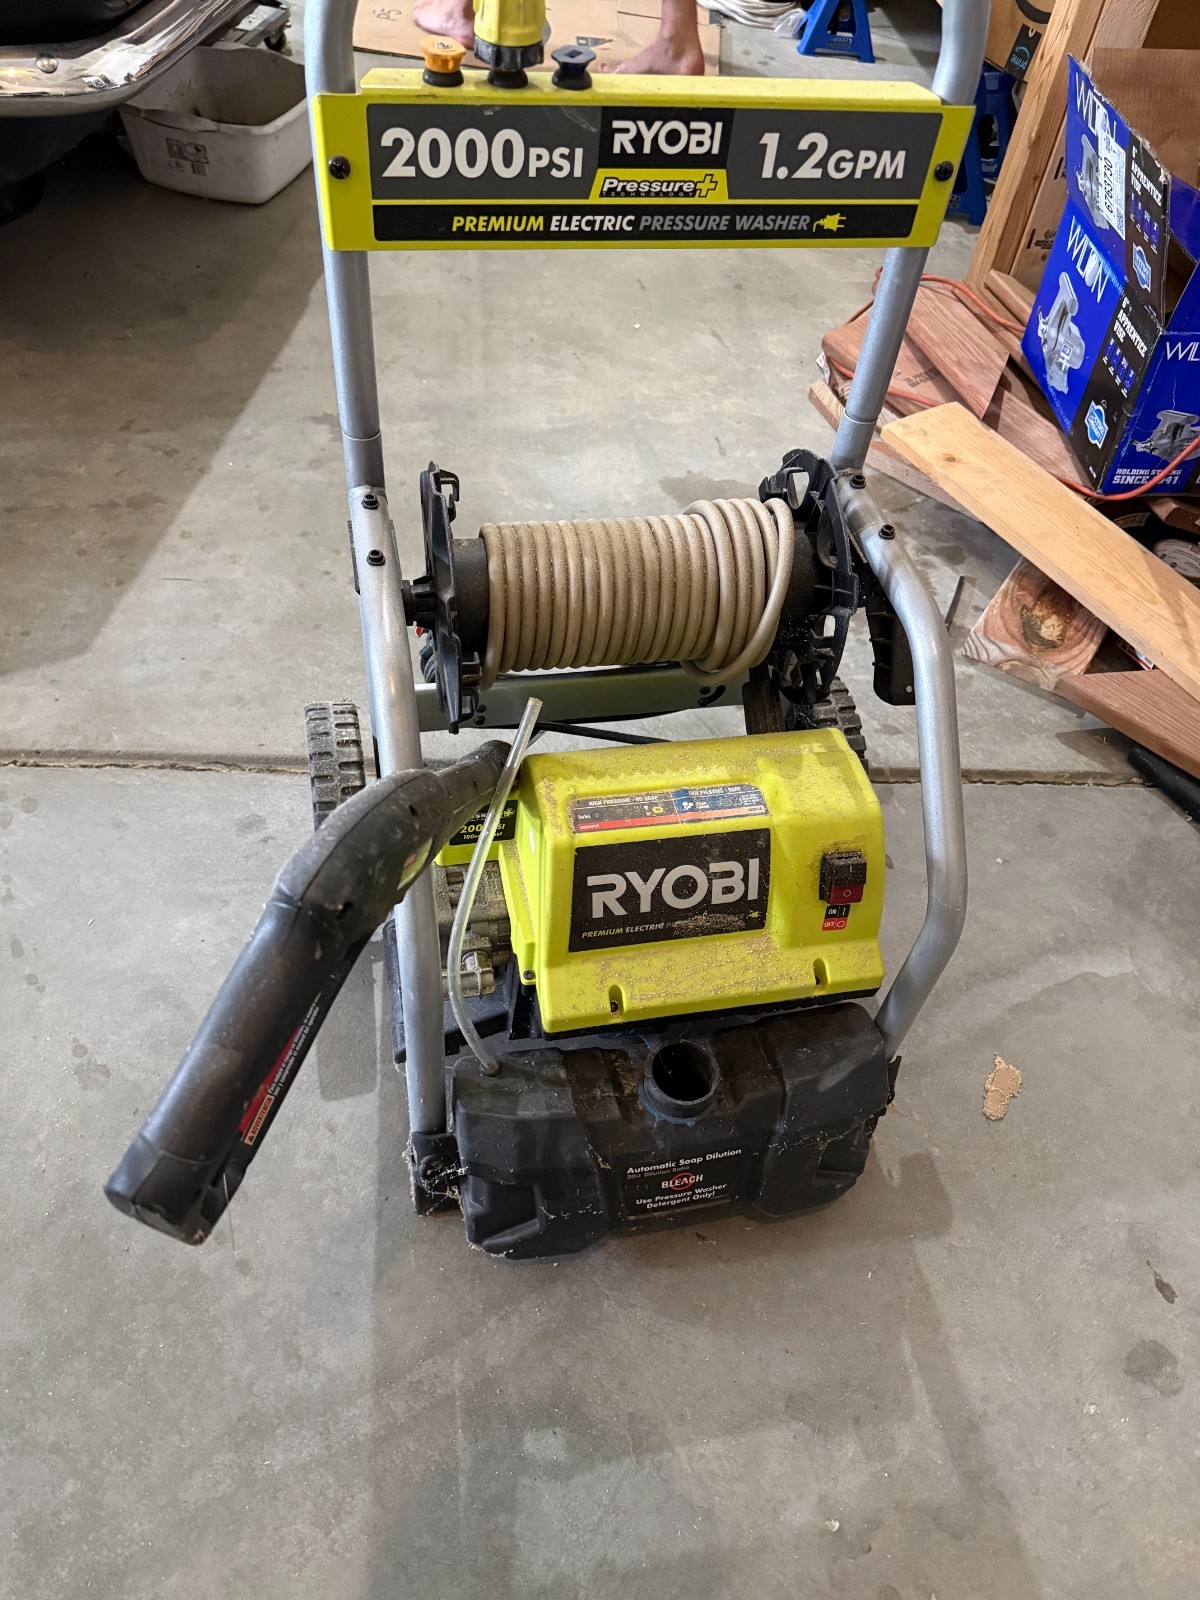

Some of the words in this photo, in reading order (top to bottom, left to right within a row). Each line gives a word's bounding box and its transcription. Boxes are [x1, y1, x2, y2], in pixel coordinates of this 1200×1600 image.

[611, 120, 723, 155] RYOBI
[1103, 156, 1114, 213] 6763730
[1130, 159, 1162, 208] APPRENTICE
[452, 215, 544, 232] PREMIUM
[550, 215, 635, 232] ELECTRIC
[639, 215, 731, 231] PRESSURE
[735, 215, 811, 231] WASHER
[1113, 319, 1127, 344] VISE
[1117, 308, 1148, 358] APPRENTICE
[1112, 475, 1150, 485] SINCE
[586, 858, 760, 919] RYOBI
[581, 927, 624, 939] PREMIUM
[625, 922, 665, 934] ELECTRIC
[251, 1096, 273, 1135] ADVERTENCIA
[626, 1161, 677, 1174] Automatic
[679, 1156, 704, 1166] Soap
[706, 1149, 742, 1160] Dilution
[644, 1169, 671, 1177] Dilution
[655, 1191, 692, 1201] Pressure
[694, 1184, 727, 1194] Washer
[662, 1174, 703, 1189] BLEACH
[646, 1197, 690, 1209] Detergent
[693, 1191, 715, 1200] Only!
